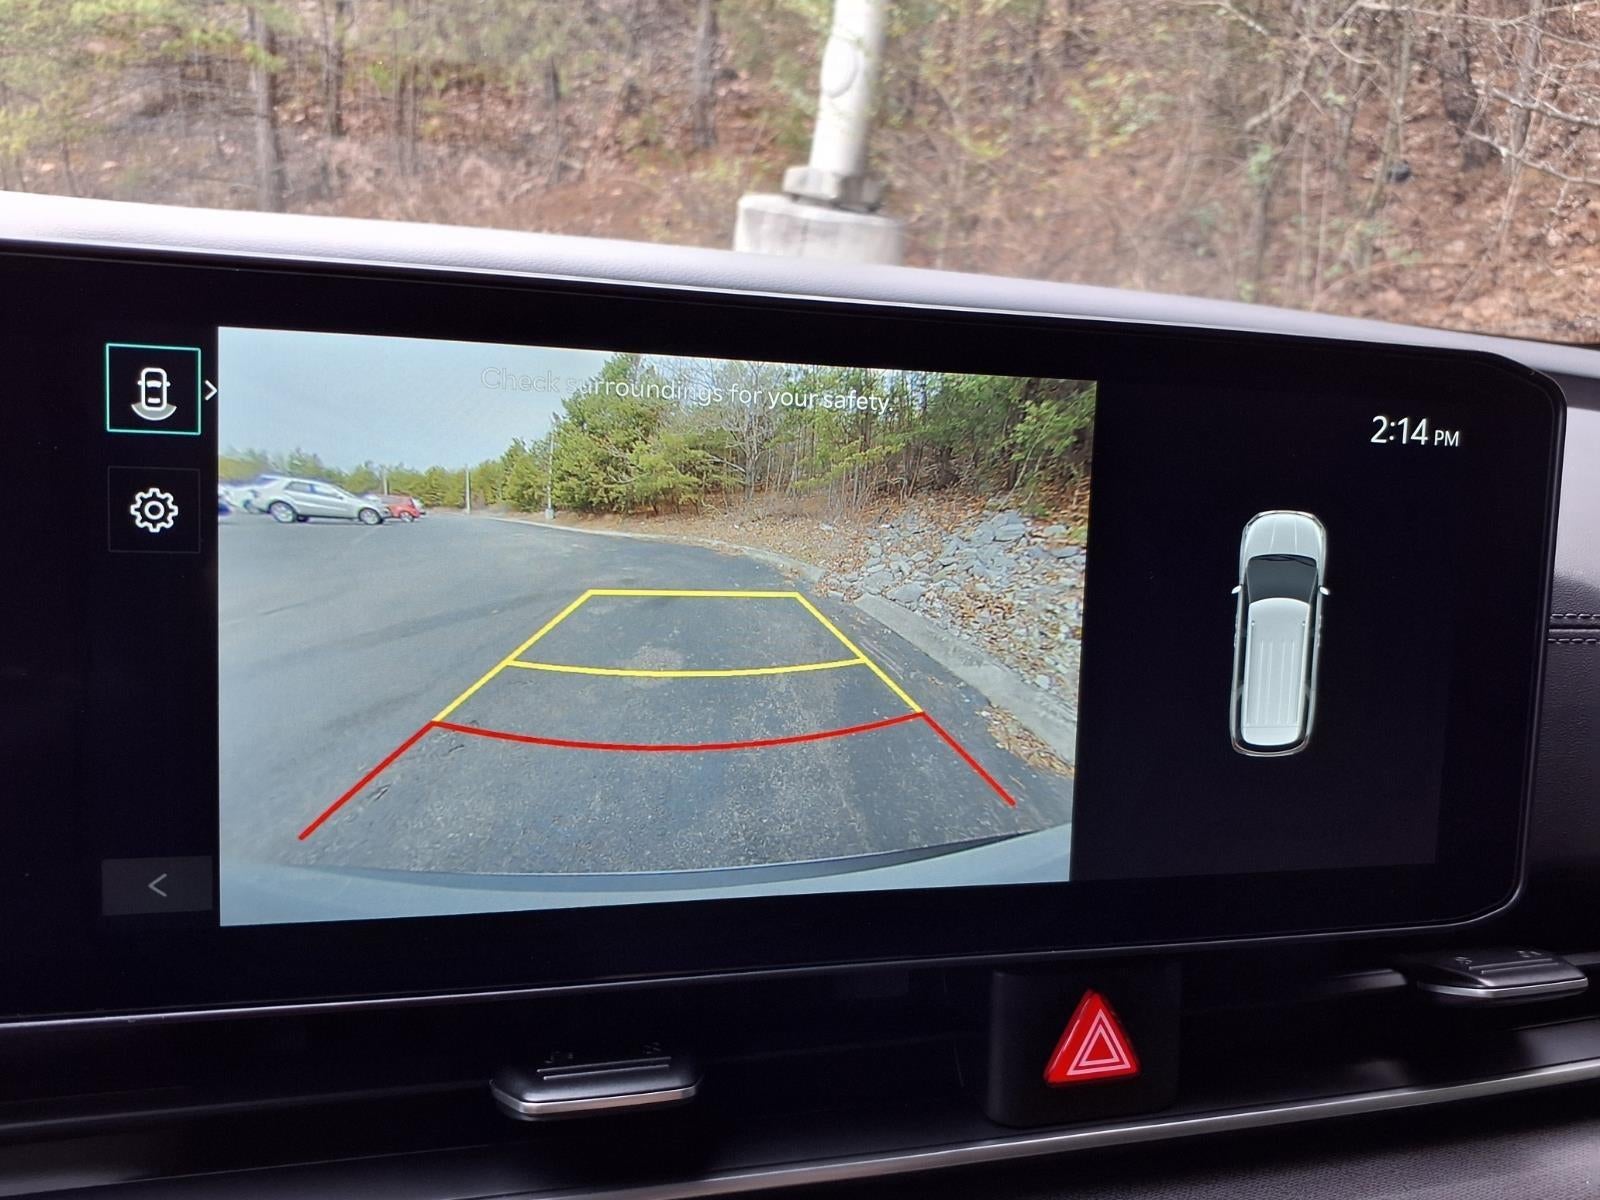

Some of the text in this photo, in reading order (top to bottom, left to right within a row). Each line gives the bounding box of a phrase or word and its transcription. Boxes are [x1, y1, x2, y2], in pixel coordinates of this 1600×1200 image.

[480, 366, 894, 416] Check surroundings for your safety.
[1370, 415, 1460, 447] 2:14 PM
